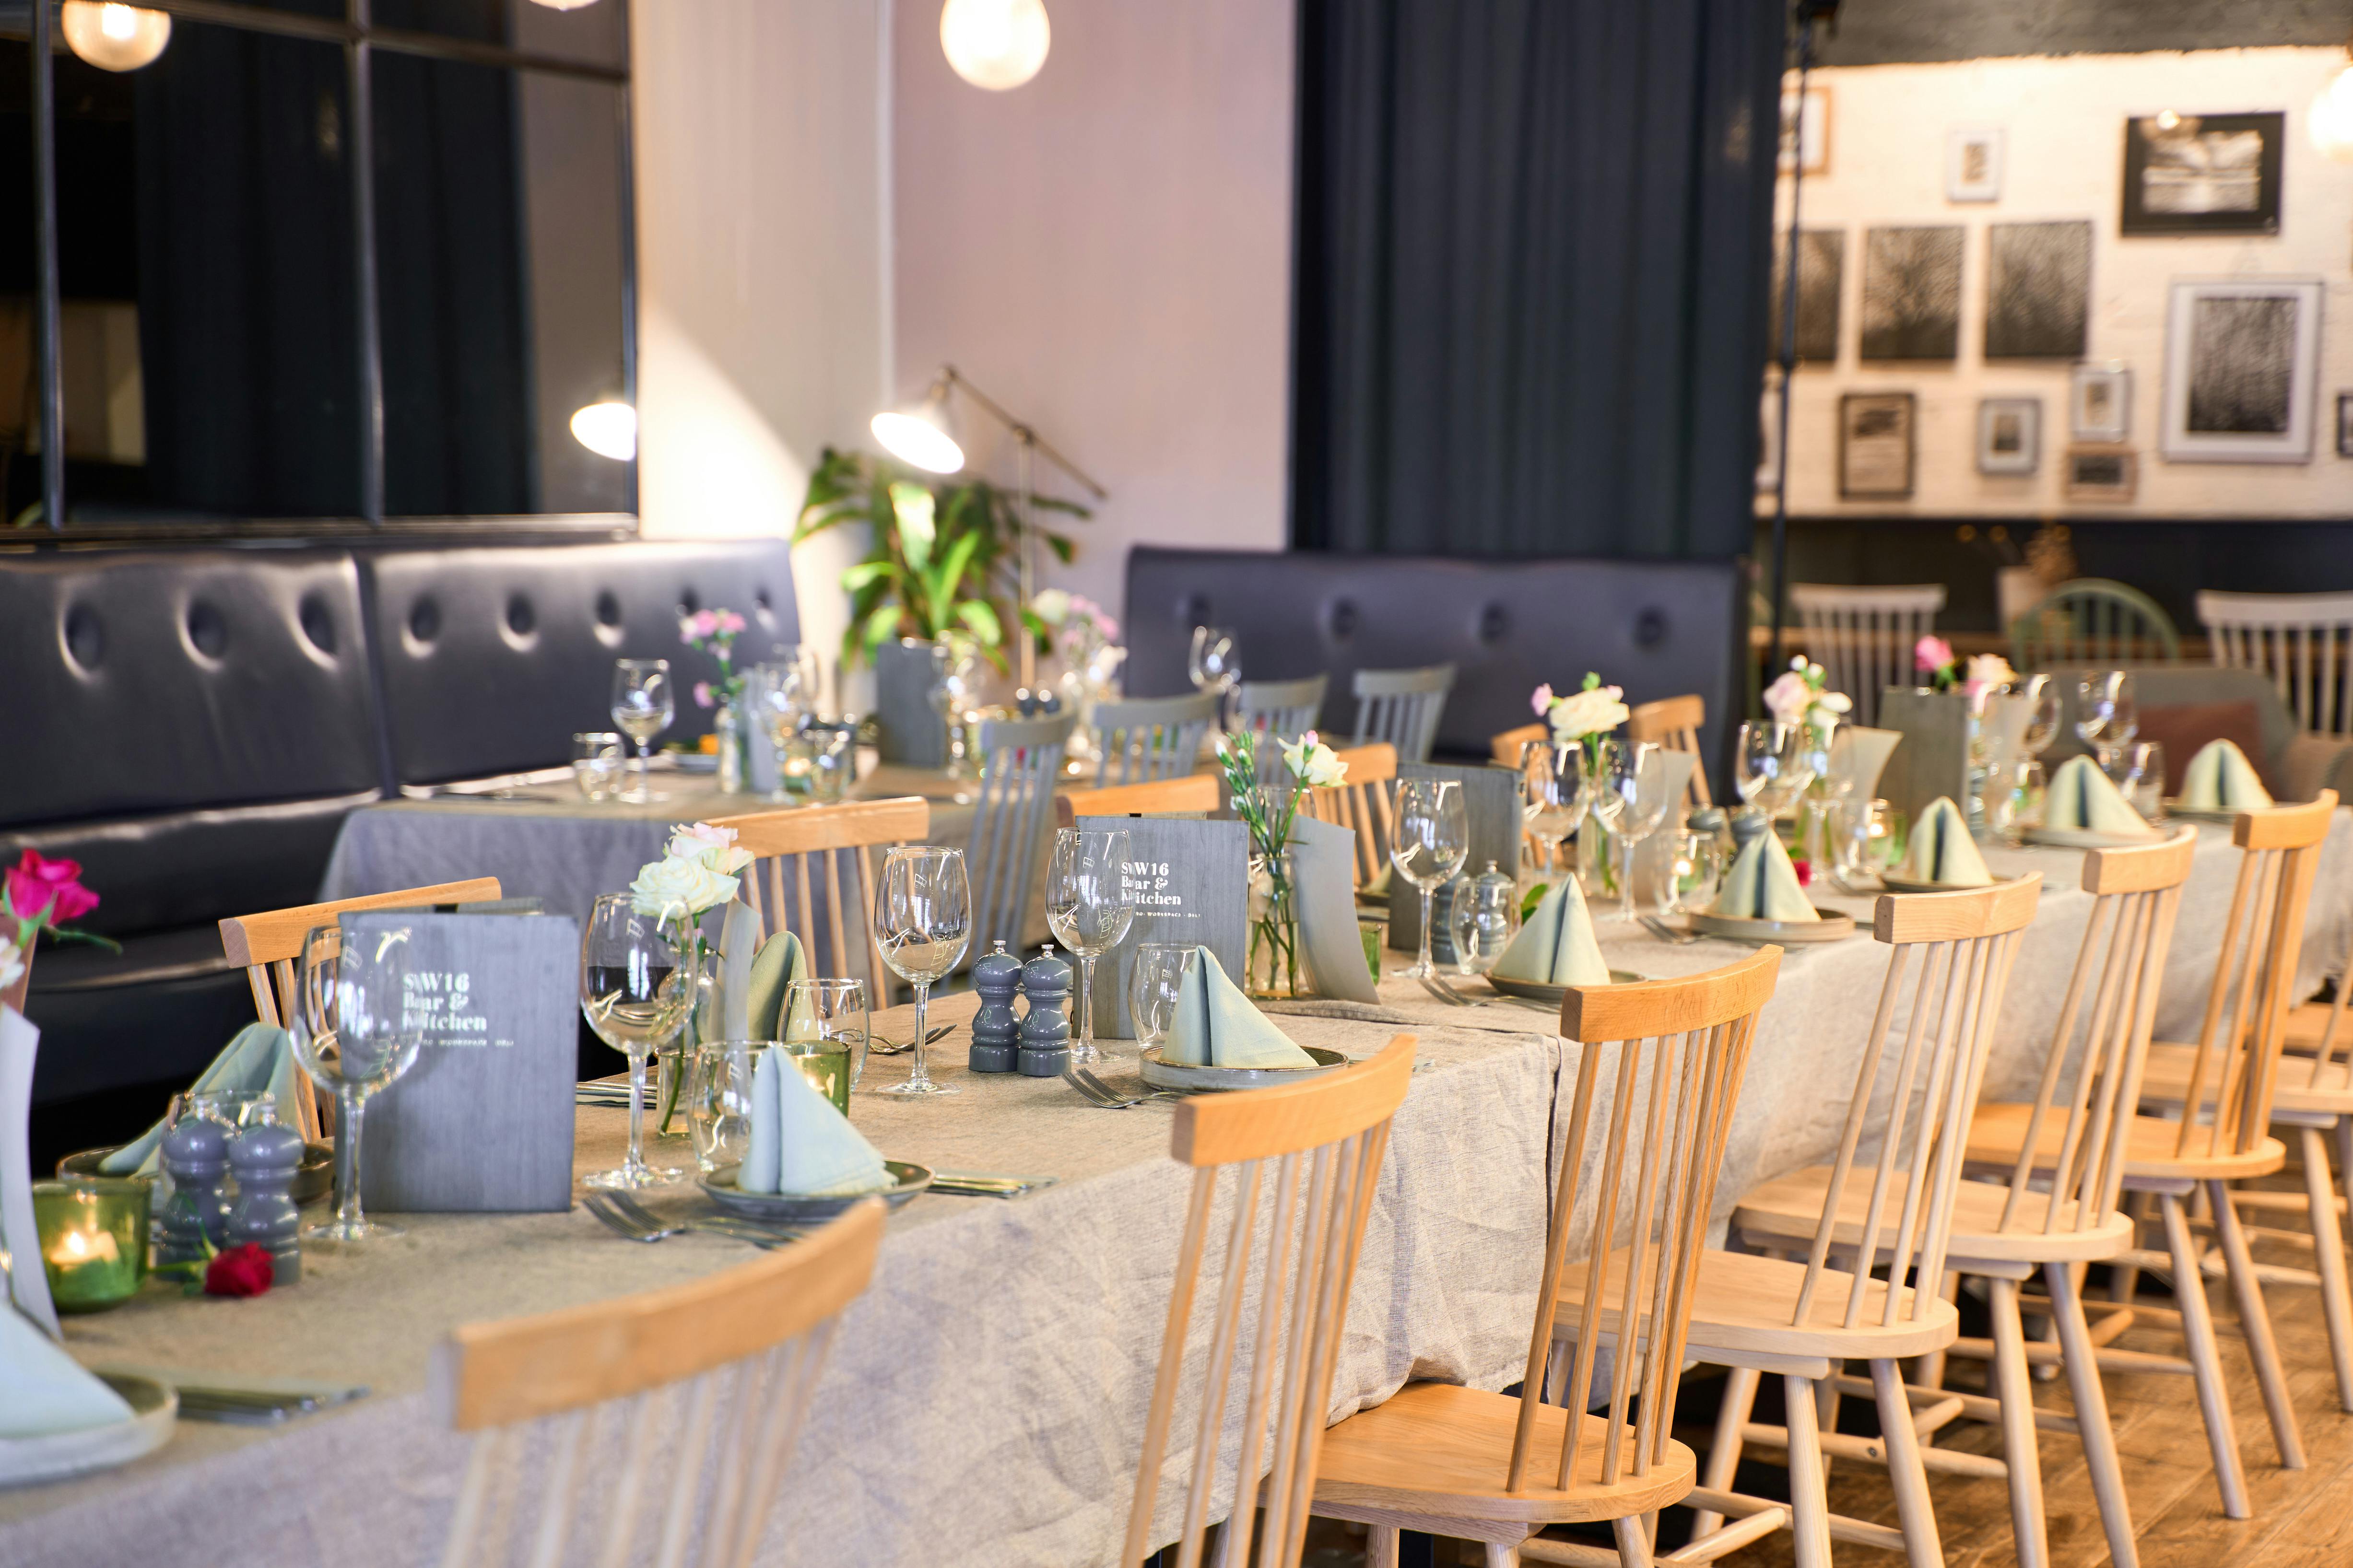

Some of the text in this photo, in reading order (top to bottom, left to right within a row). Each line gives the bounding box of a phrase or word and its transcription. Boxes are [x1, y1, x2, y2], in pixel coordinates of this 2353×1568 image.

[1121, 862, 1169, 876] SW16
[1121, 876, 1168, 890] Bar &
[1121, 889, 1181, 905] Kitchen
[403, 972, 470, 992] SW16
[403, 992, 469, 1011] Bar &
[402, 1009, 487, 1031] Kitchen
